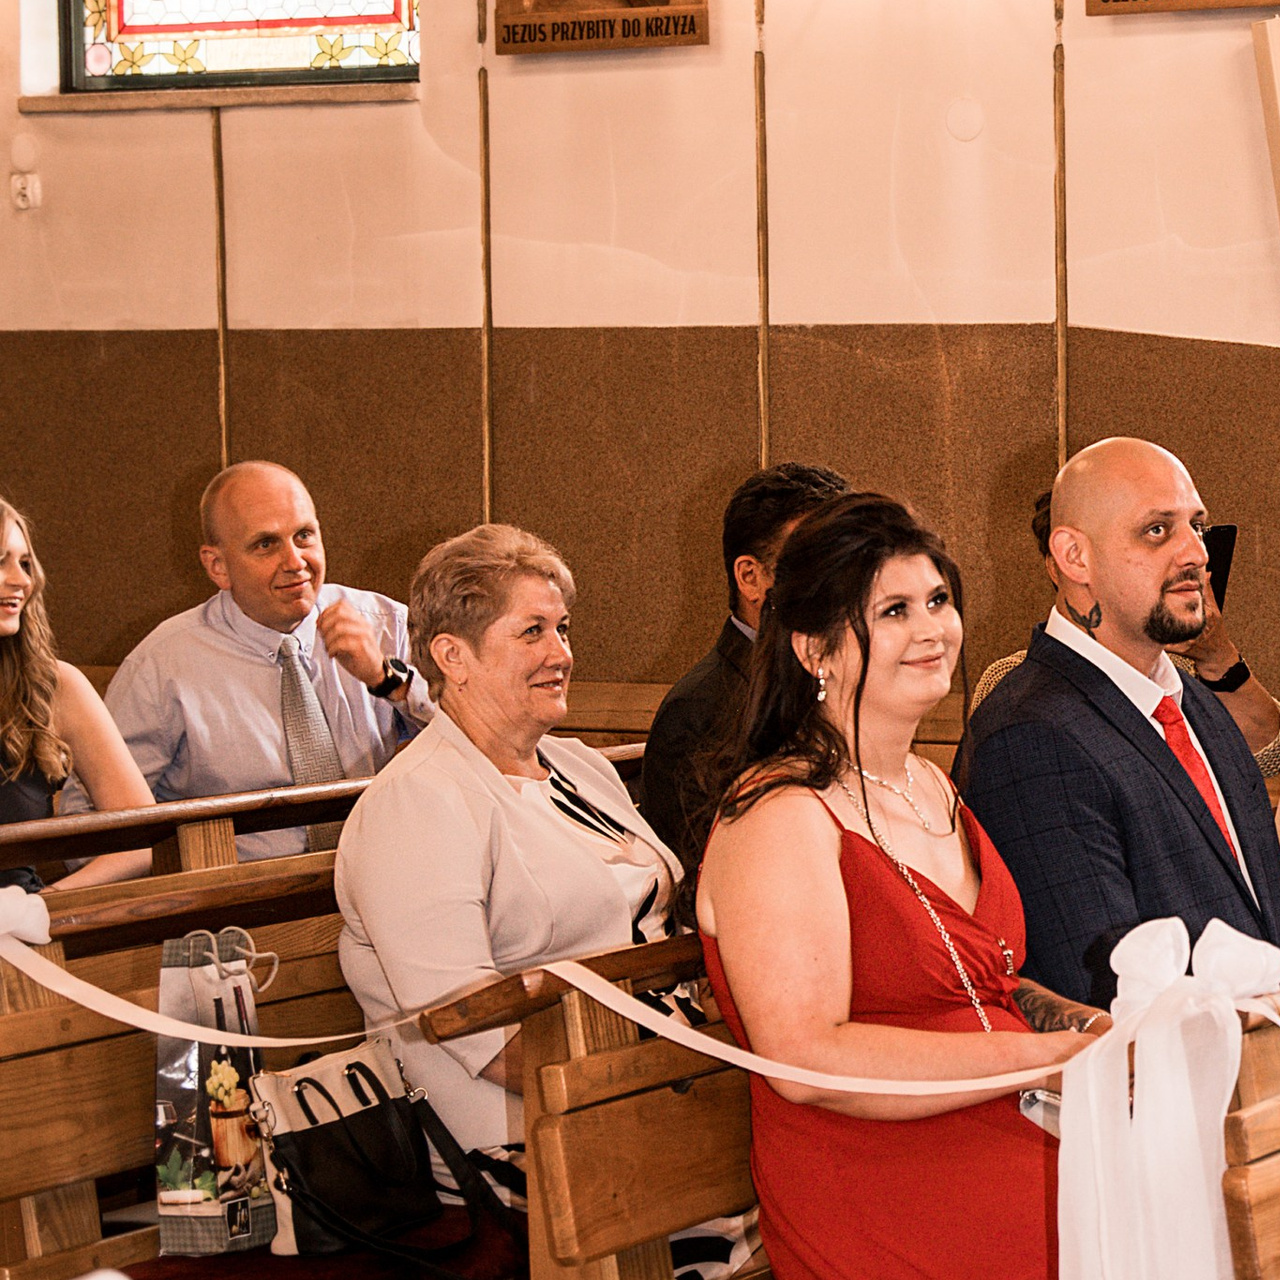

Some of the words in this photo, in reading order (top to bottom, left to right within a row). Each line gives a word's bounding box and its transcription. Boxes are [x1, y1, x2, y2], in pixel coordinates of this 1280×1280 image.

[502, 23, 547, 44] JEZUS
[551, 19, 616, 42] PRZYBITY
[622, 18, 641, 39] DO
[645, 14, 697, 38] KRZYŻA
